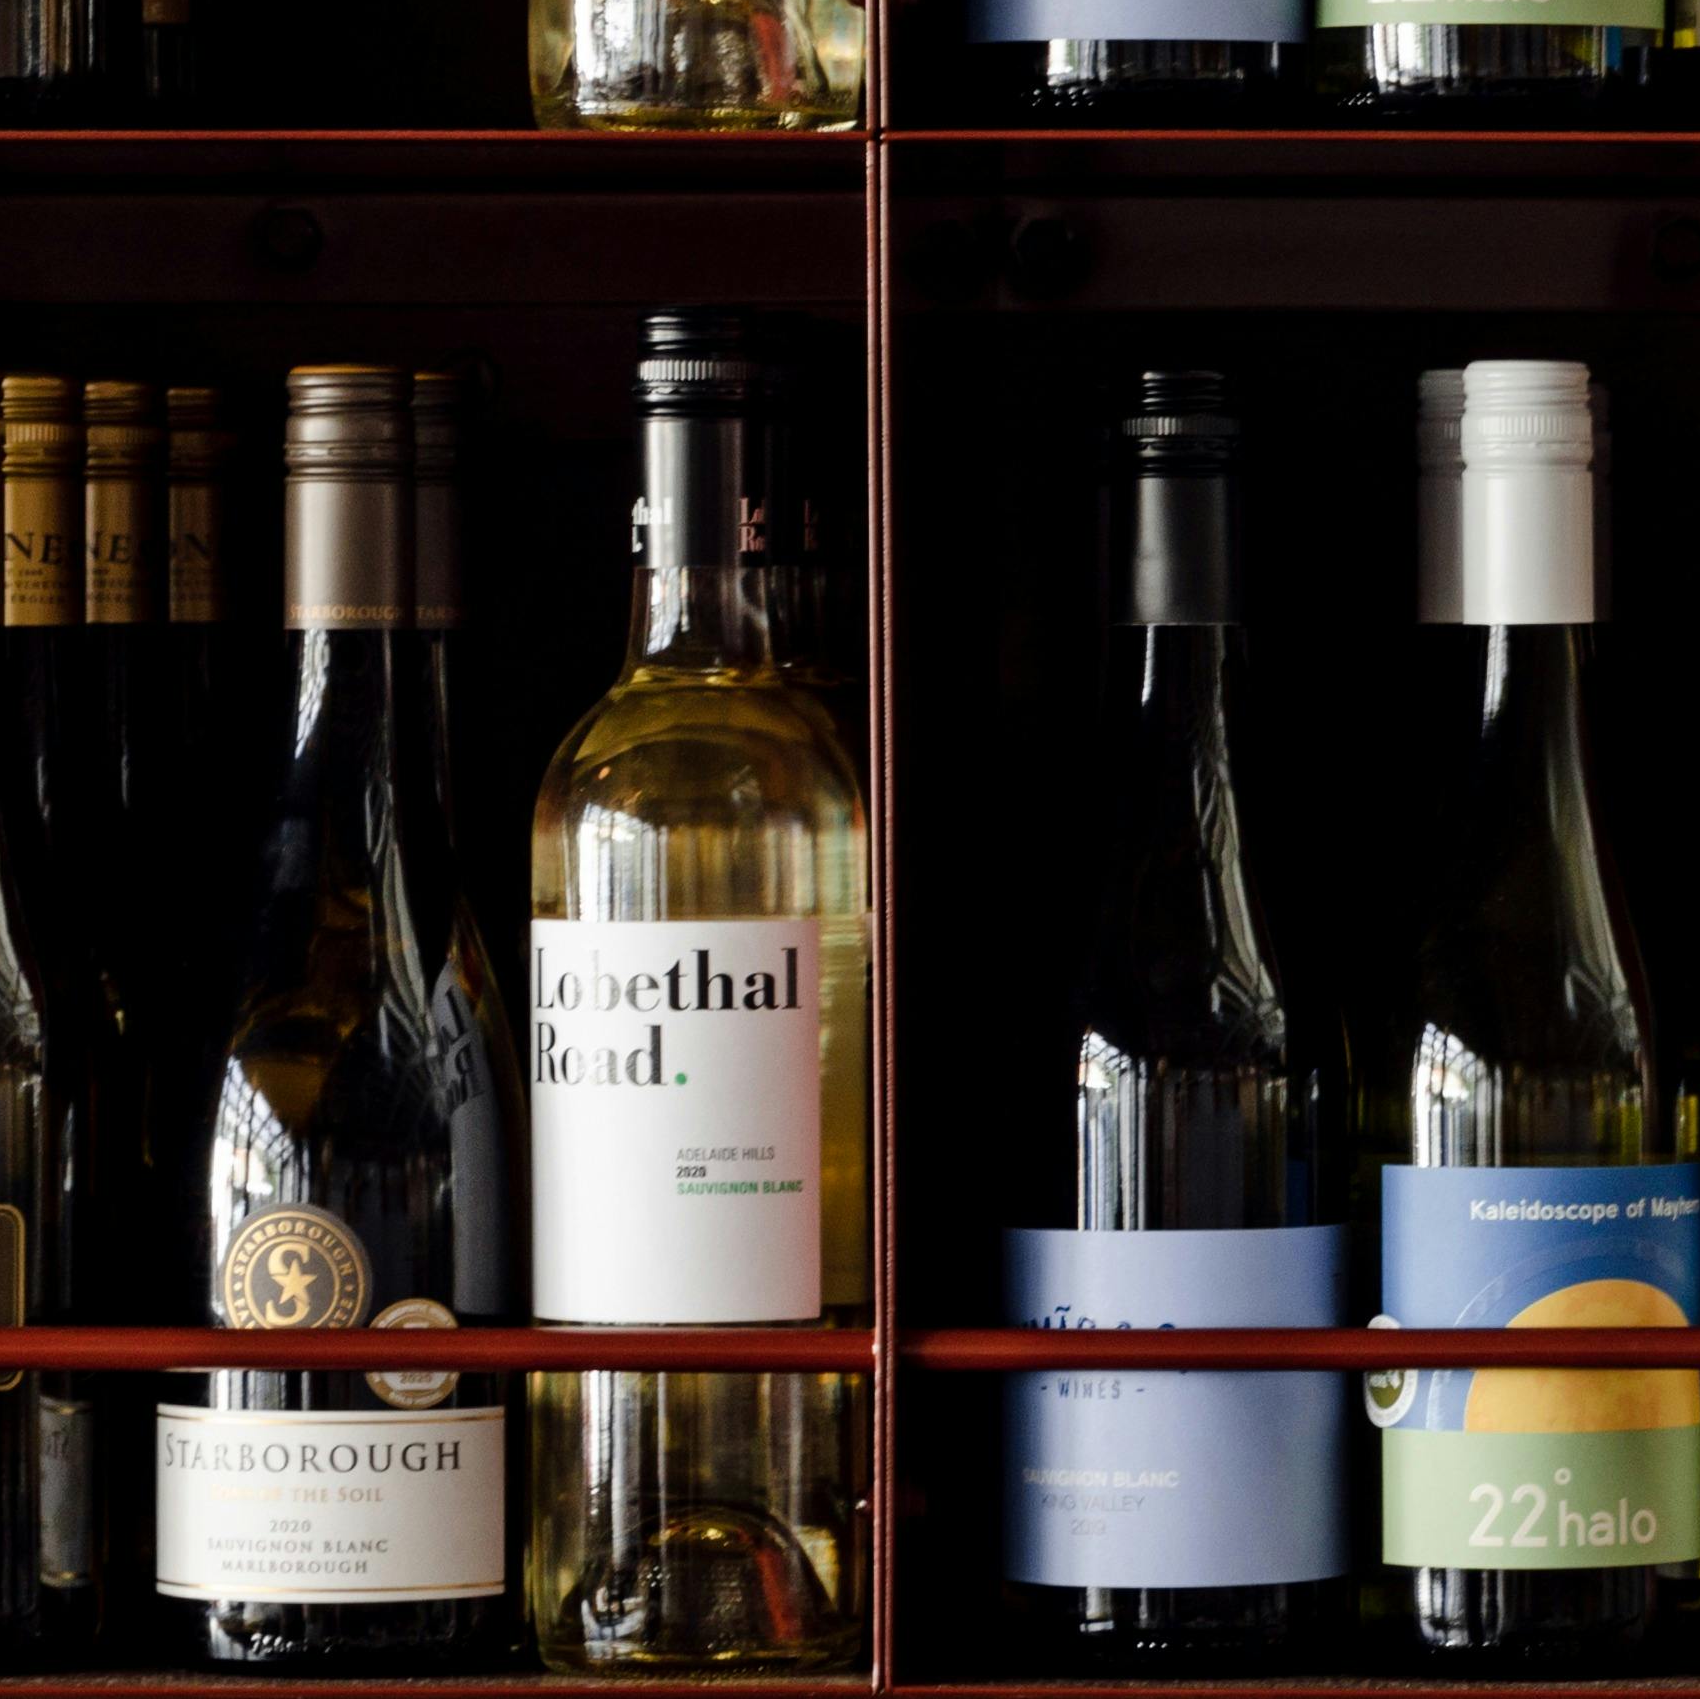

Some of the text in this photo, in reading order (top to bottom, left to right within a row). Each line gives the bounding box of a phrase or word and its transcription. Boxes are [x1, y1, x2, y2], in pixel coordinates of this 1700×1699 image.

[535, 946, 803, 1012] Lobethal
[535, 1021, 688, 1087] Road.
[676, 1145, 775, 1162] ADELAIDE HILLS
[676, 1166, 707, 1178] 2020
[676, 1179, 804, 1196] SAUVIGNON BLANC
[1469, 1197, 1646, 1226] Kaleidoscope of
[232, 1220, 355, 1278] STARBOROUGH
[1058, 1378, 1121, 1400] WINES
[164, 1432, 462, 1473] STARBOROUGH
[1113, 1469, 1180, 1489] BLANC
[337, 1487, 385, 1503] SOIL
[269, 1519, 312, 1534] 2020
[207, 1537, 389, 1554] SAUVIGNON BLANC
[221, 1559, 368, 1574] MARLBOROUGH
